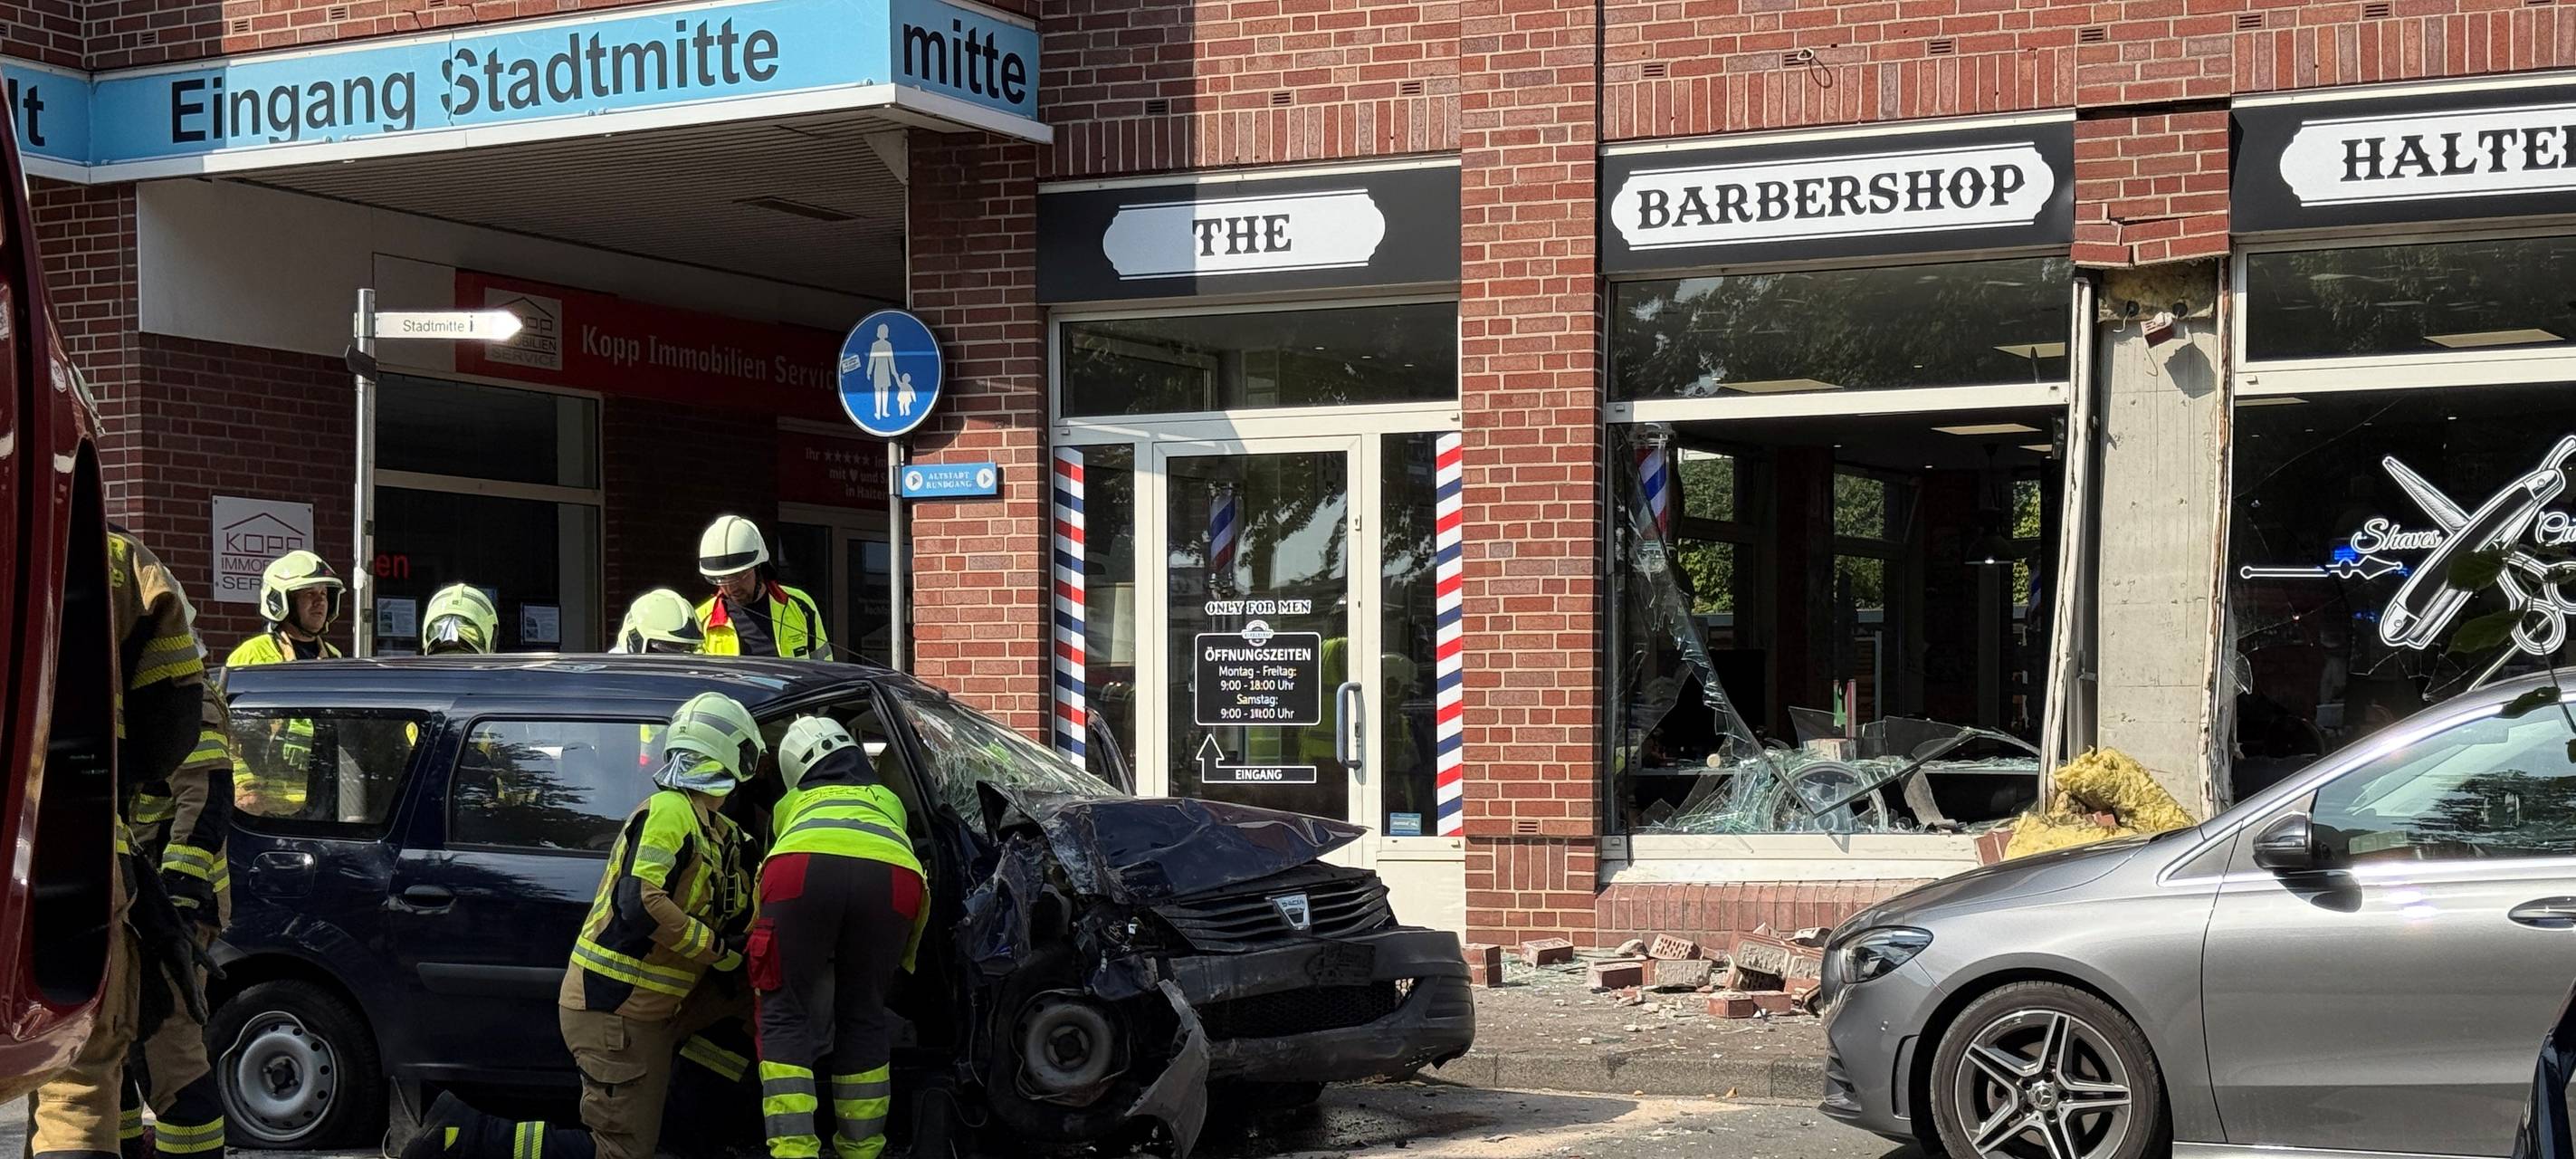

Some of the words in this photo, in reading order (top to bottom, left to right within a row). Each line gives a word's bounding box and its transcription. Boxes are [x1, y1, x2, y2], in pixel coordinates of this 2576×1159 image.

[902, 18, 1027, 104] mitte
[171, 72, 415, 144] Eingang
[441, 16, 779, 117] Stadtmitte
[1636, 163, 2026, 231] BARBERSHOP
[1192, 214, 1293, 257] THE
[403, 319, 465, 333] Stadtmitte
[582, 324, 641, 367] Kopp
[648, 334, 768, 381] Immobilien
[775, 355, 835, 391] Servic
[225, 532, 303, 554] KOPP
[2351, 517, 2444, 553] Shaves
[1205, 600, 1245, 616] ONLY
[1245, 600, 1276, 615] FOR
[1278, 599, 1312, 615] MEN
[1205, 647, 1312, 662] ÖFFNUNGSZEITEN
[1218, 666, 1255, 679] Montag
[1262, 666, 1297, 679] Freitag:
[1220, 680, 1242, 691] 9:00
[1249, 680, 1275, 691] 18:00
[1277, 679, 1295, 691] Uhr
[1236, 694, 1279, 707] Samstag:
[1220, 708, 1242, 719] 9:00
[1277, 707, 1295, 719] Uhr
[1235, 769, 1283, 781] EINGANG
